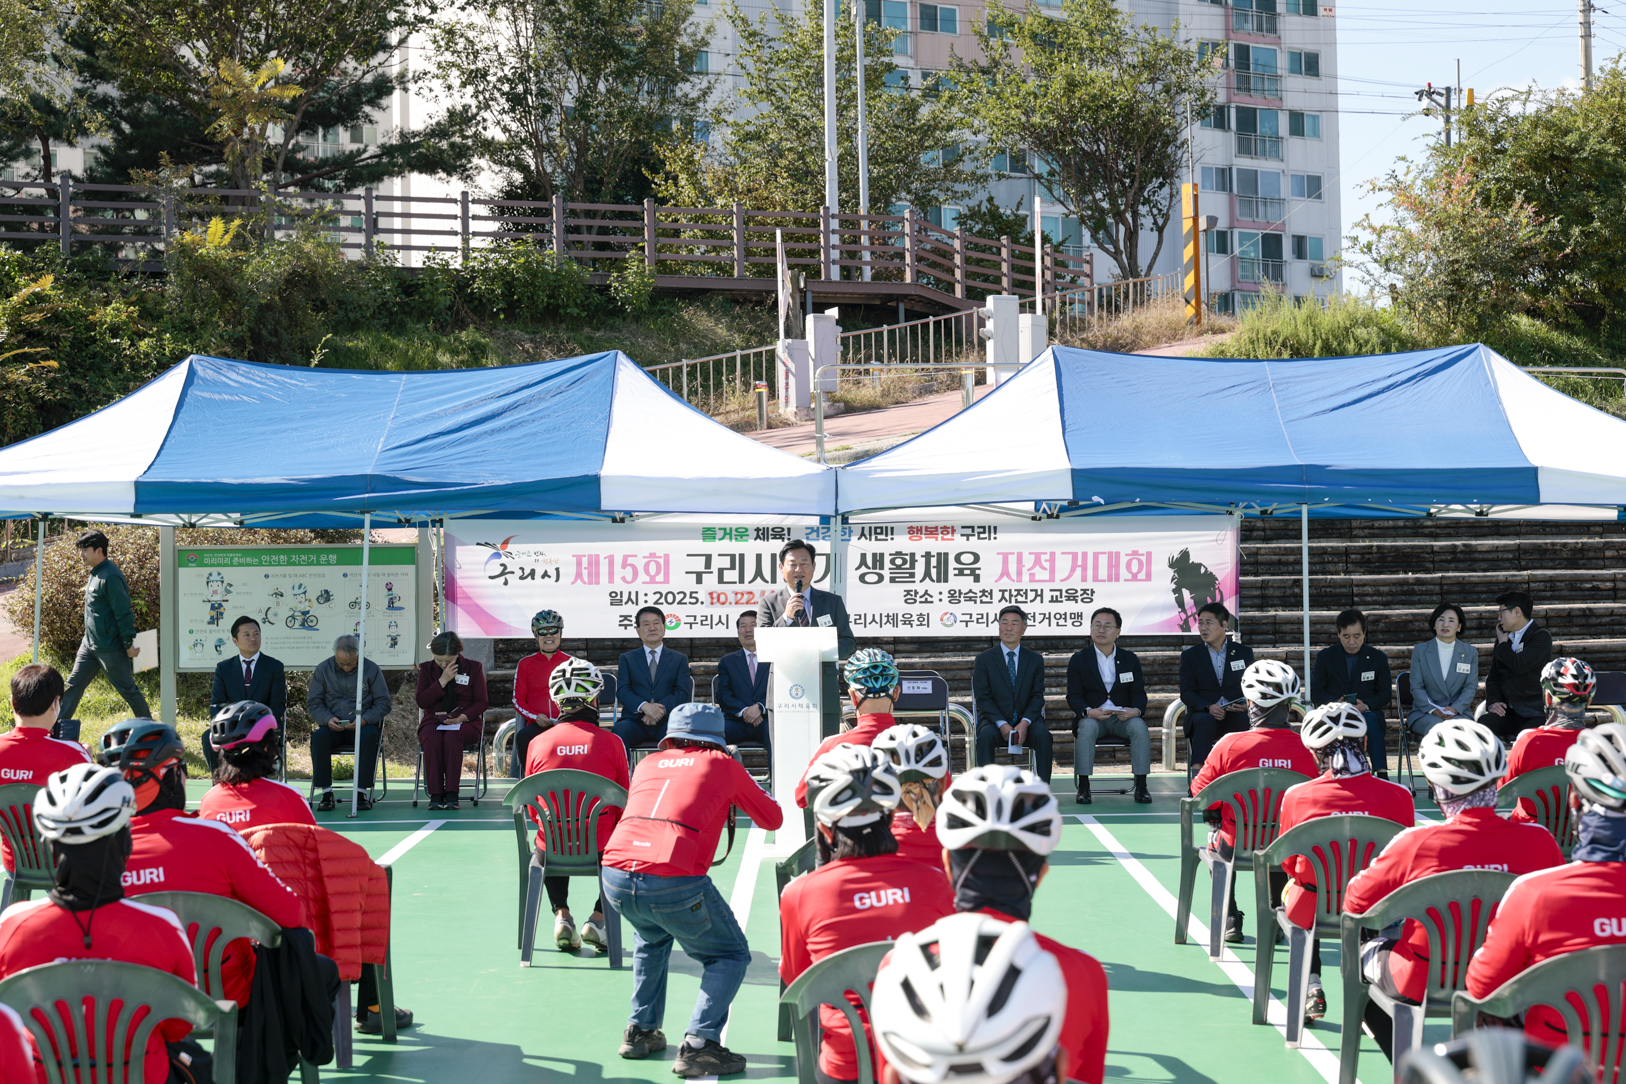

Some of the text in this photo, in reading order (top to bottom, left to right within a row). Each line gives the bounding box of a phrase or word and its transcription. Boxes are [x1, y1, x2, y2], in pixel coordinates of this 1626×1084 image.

[701, 526, 750, 543] 즐거운
[754, 526, 792, 542] 체육!
[857, 525, 895, 542] 시민!
[907, 525, 957, 542] 행복한
[960, 525, 998, 542] 구리!
[203, 554, 337, 565] 미리미리 준비하는 안전한 자전거 운행
[571, 549, 1153, 586] 제15회 구리시기 생활체육 자전거대회
[488, 562, 561, 586] 구리시
[608, 590, 640, 606] 일시
[652, 590, 705, 606] 2025.
[903, 589, 934, 604] 장소
[947, 589, 994, 604] 왕숙천
[998, 588, 1044, 604] 자전거
[1048, 588, 1096, 604] 교육장
[618, 614, 637, 630] 주
[683, 614, 730, 630] 구리시
[777, 702, 818, 710] 구리시체육회
[556, 744, 589, 756] GURI
[657, 757, 696, 769] GURI
[1, 768, 34, 780] GURI
[216, 810, 251, 824] GURI
[632, 840, 652, 848] Bicycle
[120, 867, 165, 886] GURI
[853, 886, 911, 910] GURI
[1593, 917, 1626, 937] GU
